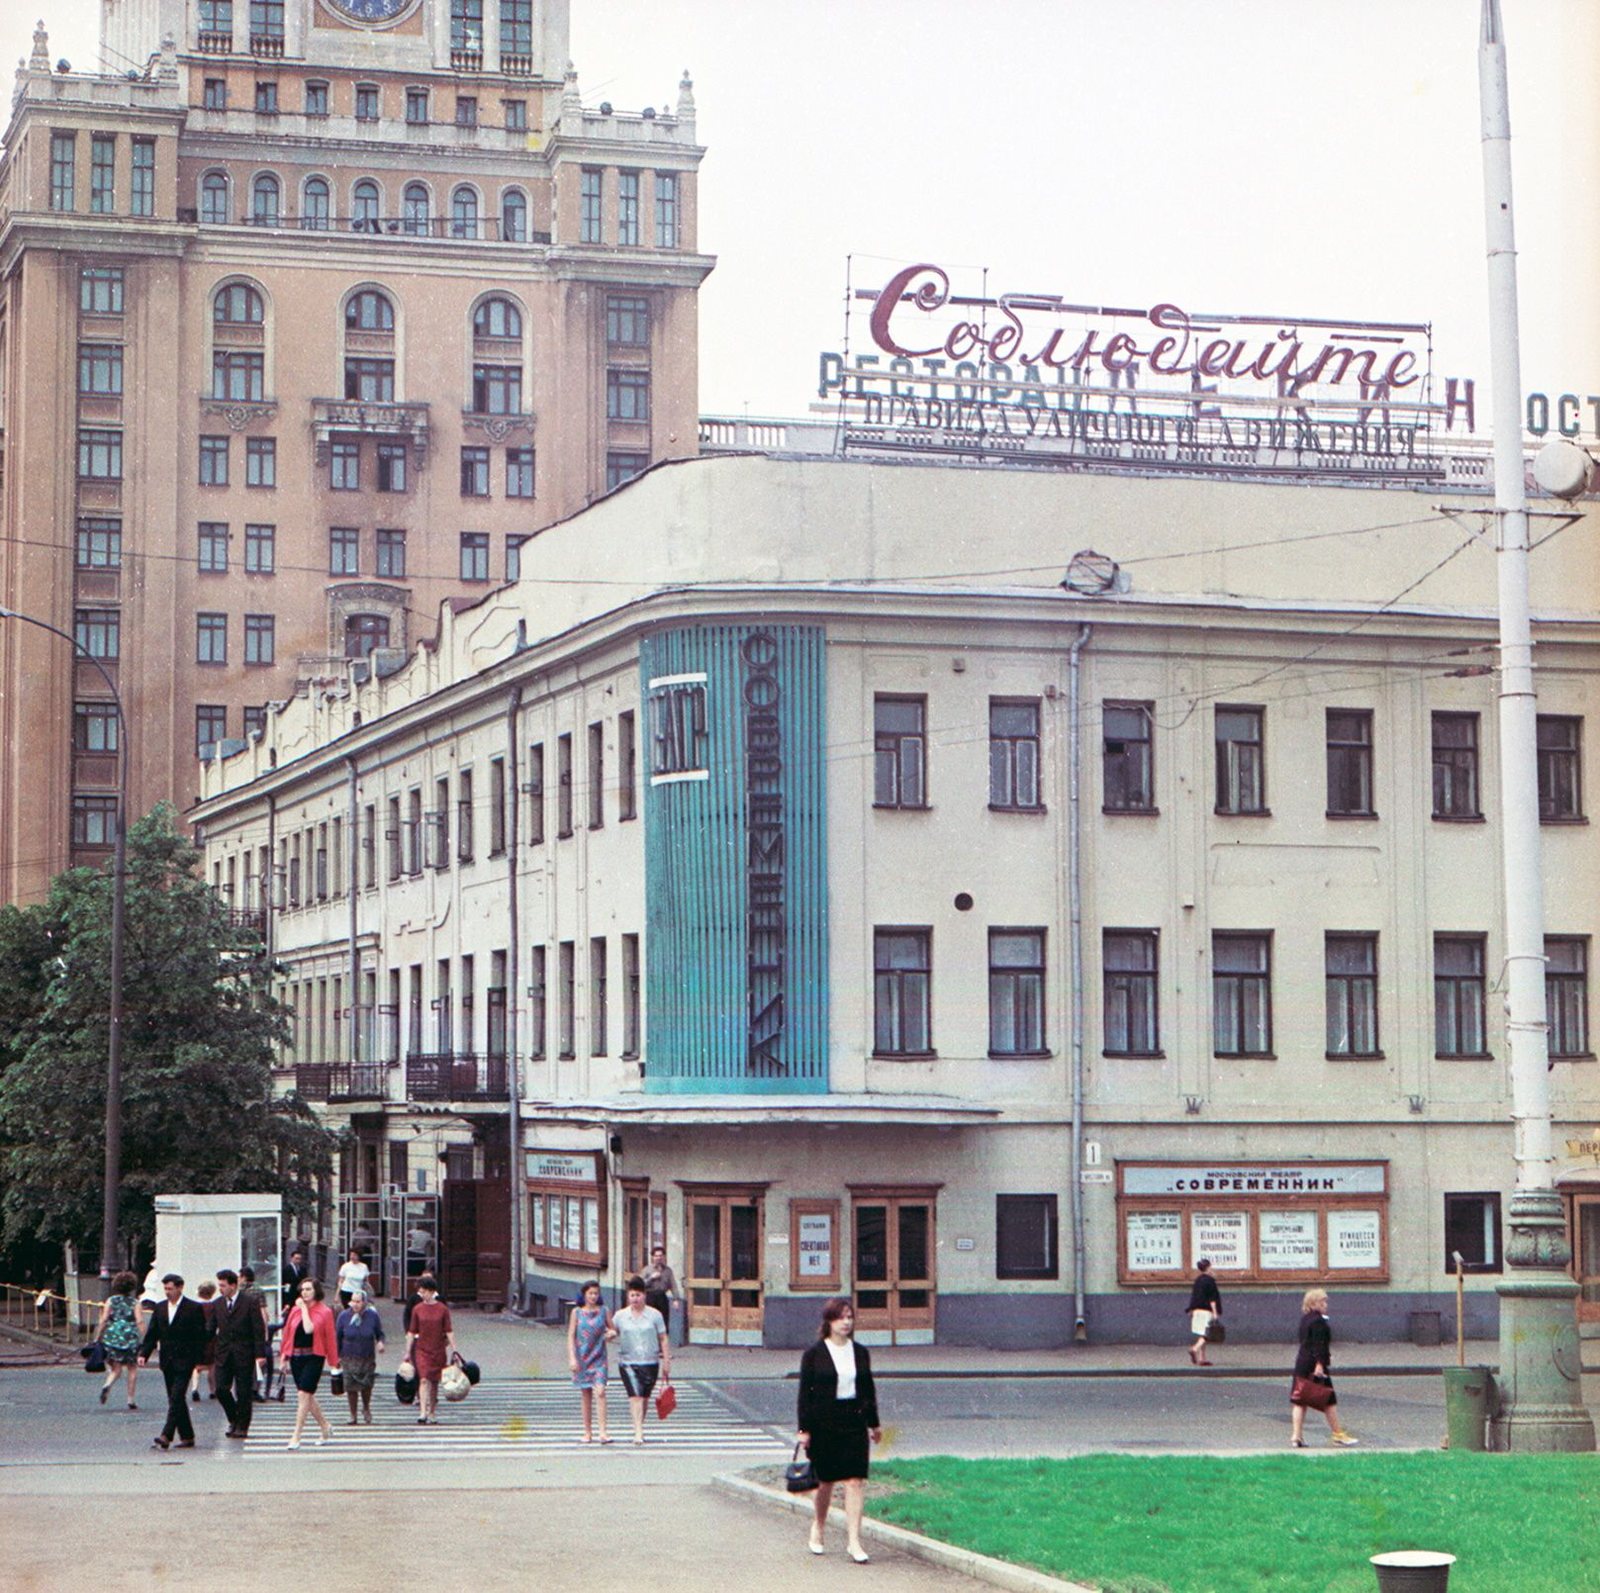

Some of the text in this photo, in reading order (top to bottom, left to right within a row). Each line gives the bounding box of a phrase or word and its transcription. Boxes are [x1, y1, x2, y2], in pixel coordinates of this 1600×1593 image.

[870, 262, 1420, 389] Соблюдайте
[818, 351, 1082, 412] РЕСТОРАН
[1526, 391, 1600, 440] ОСТ
[864, 392, 1016, 438] ПРАВИЛА
[740, 632, 786, 1070] СОВРЕМЕННИК
